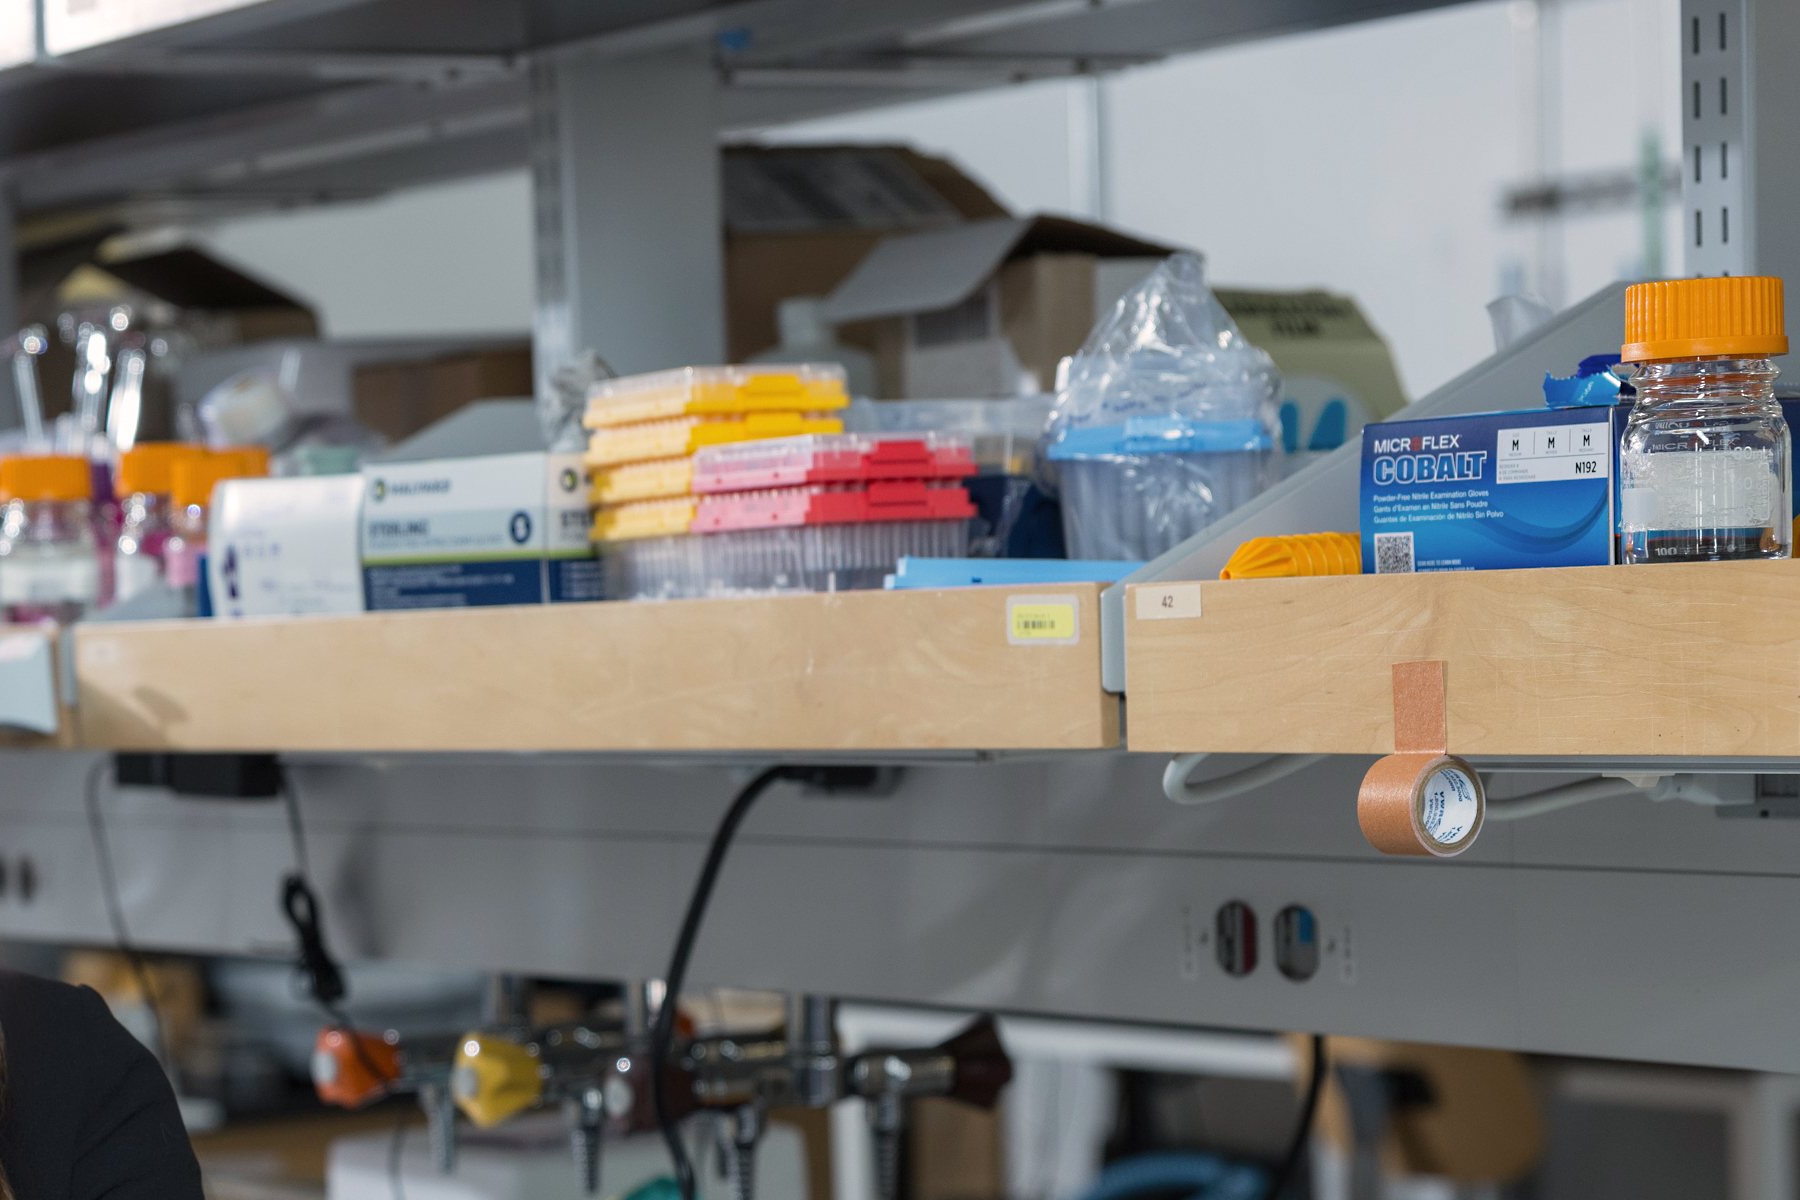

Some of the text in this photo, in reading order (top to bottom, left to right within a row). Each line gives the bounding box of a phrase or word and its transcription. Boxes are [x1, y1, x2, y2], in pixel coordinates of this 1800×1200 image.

[1374, 434, 1460, 454] MICROFLEX
[1512, 434, 1590, 451] M M M
[1373, 451, 1487, 485] COBALT
[1575, 461, 1597, 474] N192
[1373, 489, 1489, 502] Powder-Free Nitrile Examination Gloves
[1374, 505, 1391, 513] Gants
[1431, 502, 1449, 510] Nitrile
[1450, 501, 1465, 510] Sans
[1466, 500, 1488, 508] Poudre
[1374, 515, 1398, 524] Guantes
[1447, 512, 1455, 520] de
[1475, 510, 1485, 519] Sin
[1486, 509, 1504, 518] Polvo
[1161, 595, 1174, 608] 42
